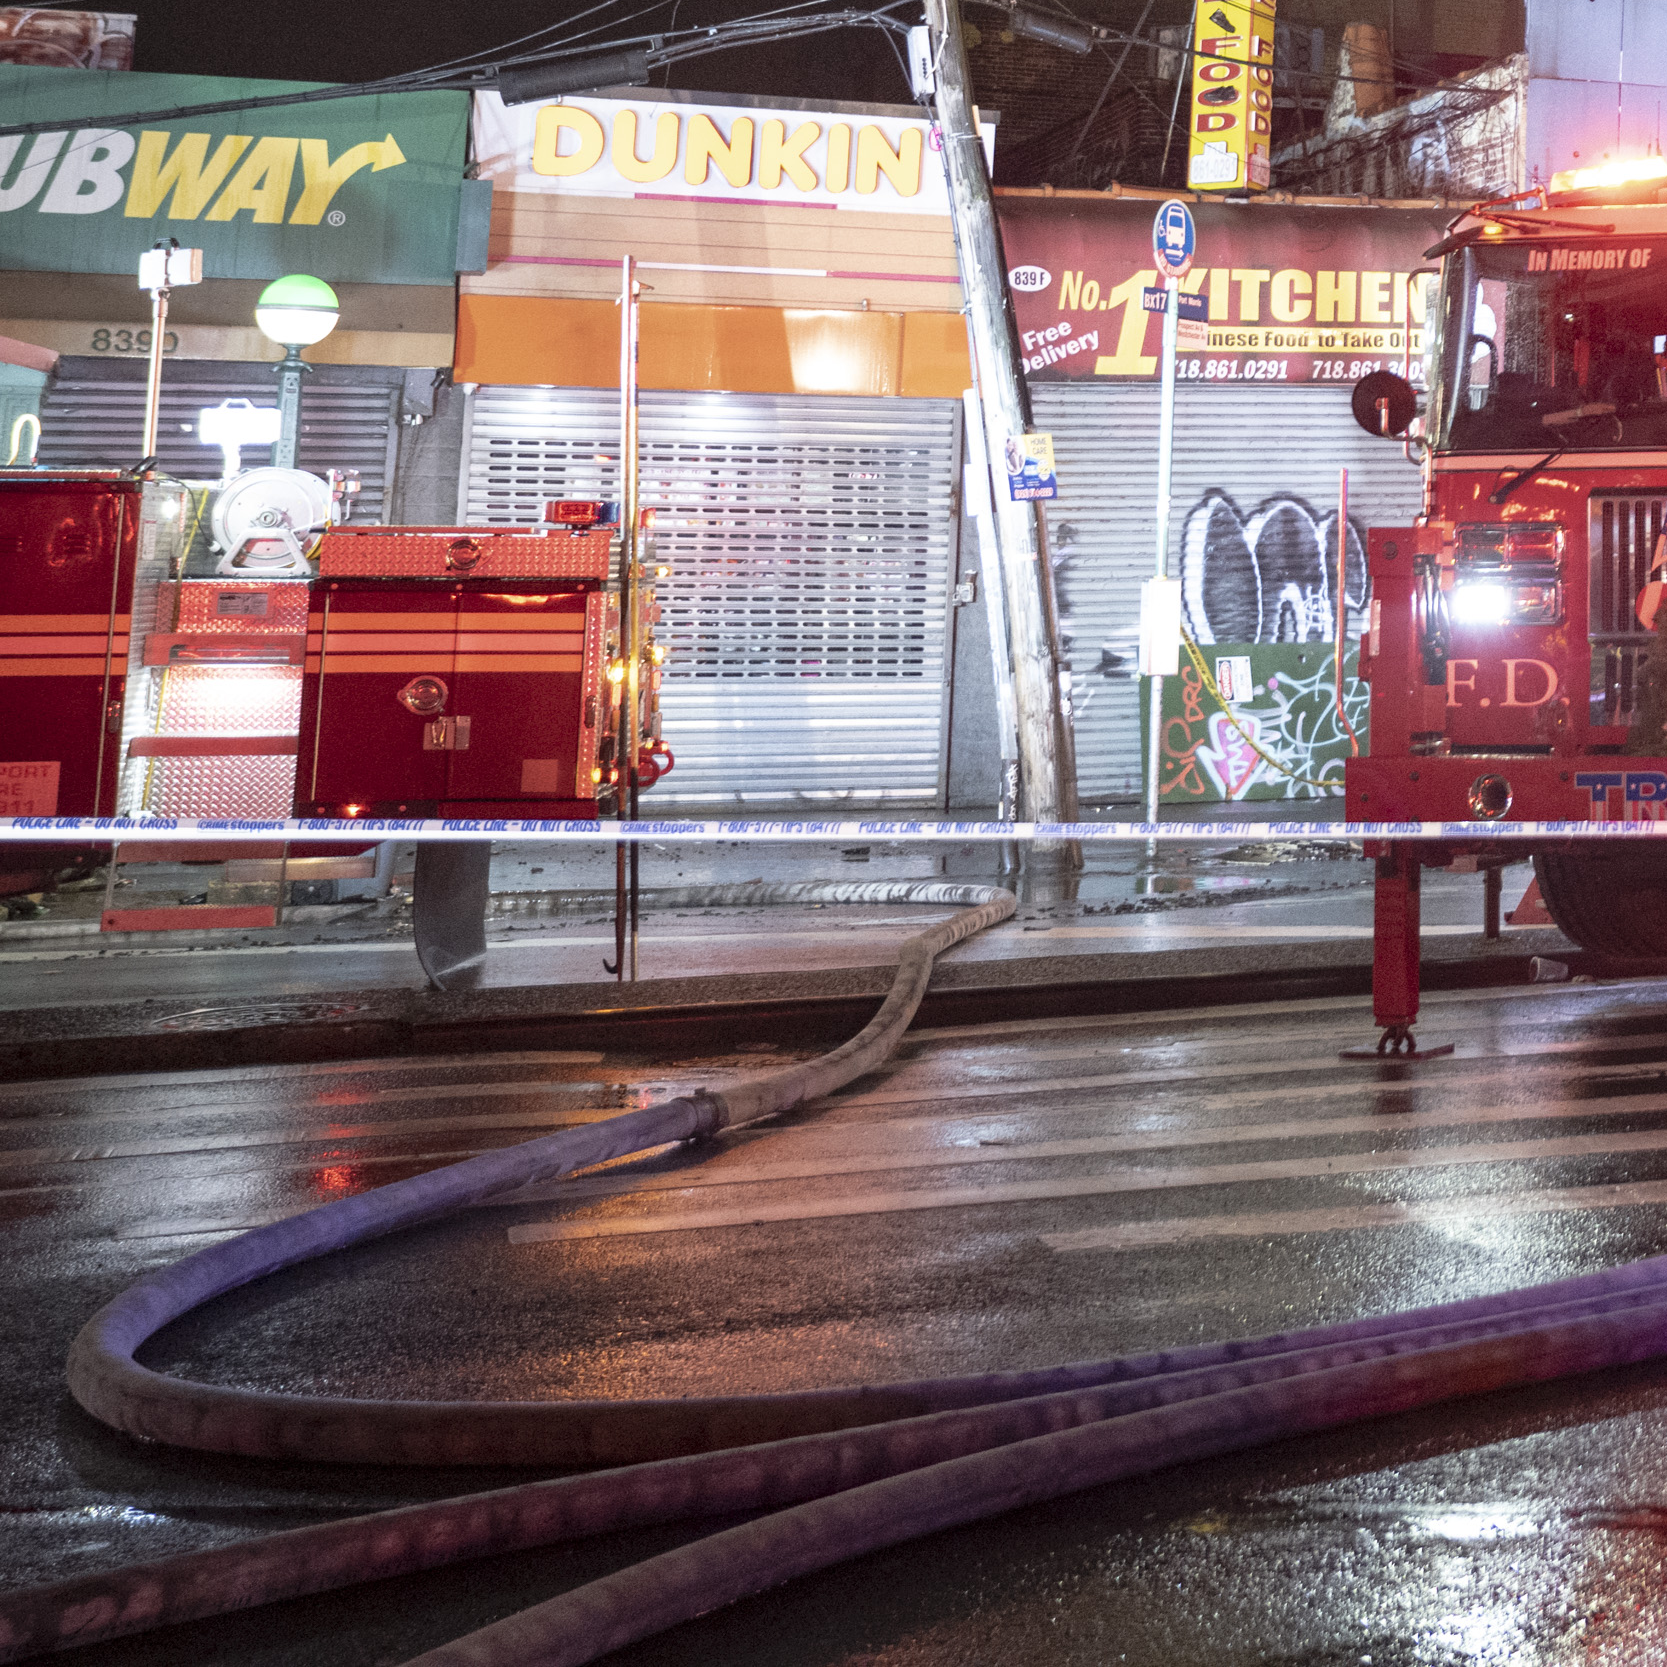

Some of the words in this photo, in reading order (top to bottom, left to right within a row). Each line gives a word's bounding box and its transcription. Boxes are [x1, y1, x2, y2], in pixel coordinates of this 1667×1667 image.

[1196, 35, 1242, 133] FOOD
[1251, 36, 1276, 136] FOOD
[1528, 250, 1549, 272] IN
[1550, 249, 1621, 271] MEMORY
[1625, 248, 1652, 269] OF
[1014, 271, 1036, 286] 839
[1038, 271, 1046, 286] F
[1058, 271, 1108, 311] No.
[1143, 292, 1167, 311] BX17
[1023, 319, 1073, 351] Free
[1264, 331, 1310, 348] Food
[1318, 331, 1337, 348] to
[1342, 331, 1384, 348] Take
[1443, 658, 1571, 707] F.D.
